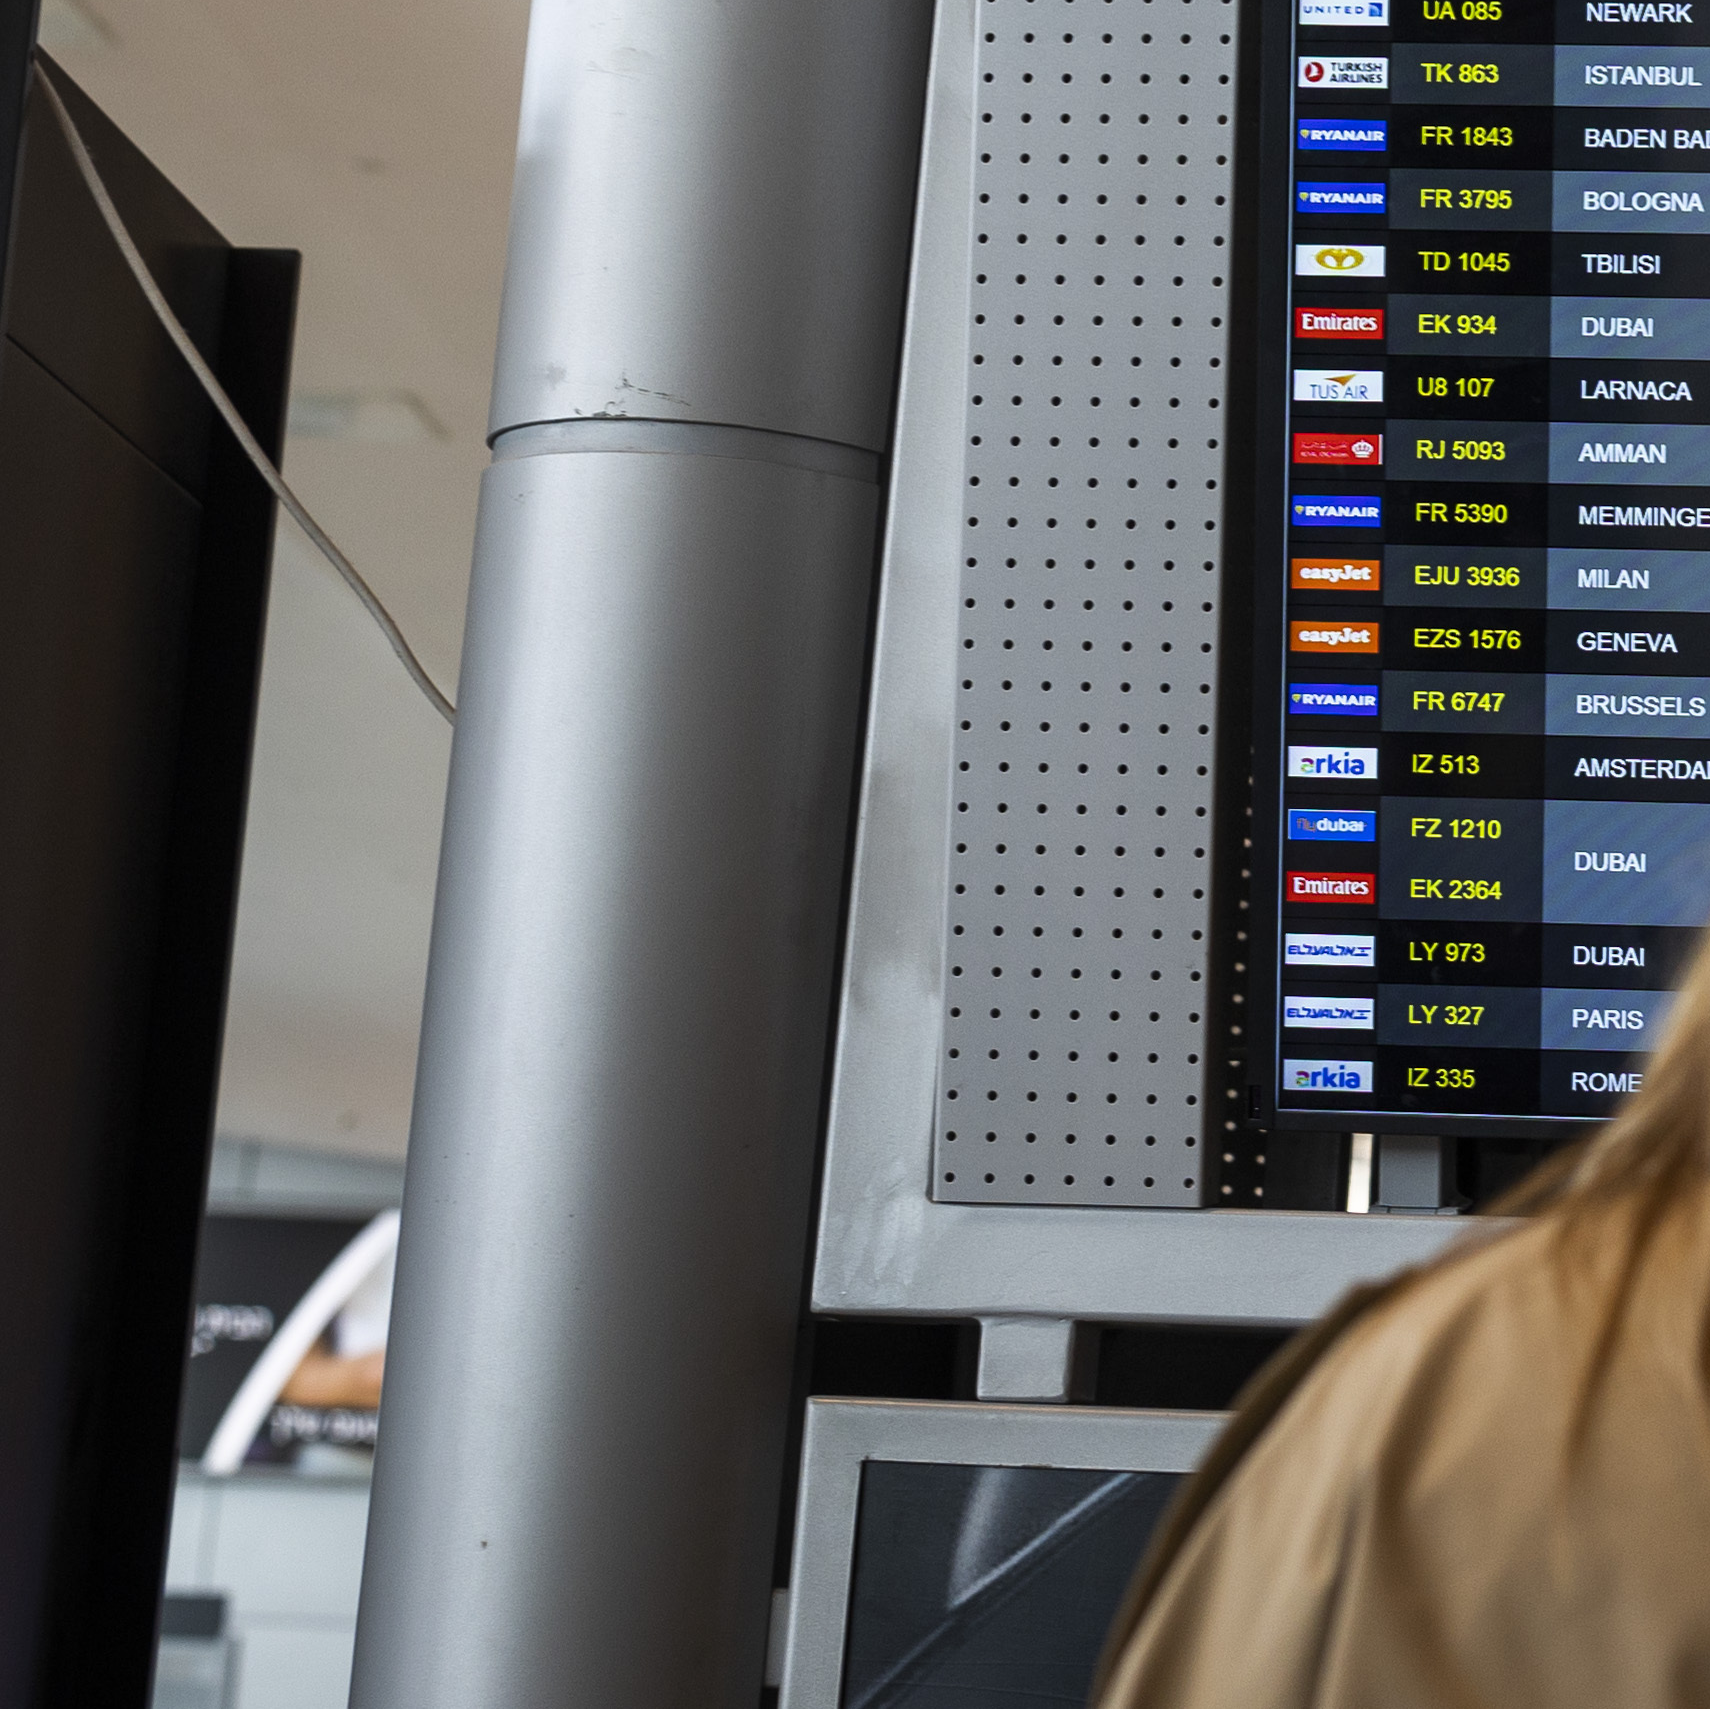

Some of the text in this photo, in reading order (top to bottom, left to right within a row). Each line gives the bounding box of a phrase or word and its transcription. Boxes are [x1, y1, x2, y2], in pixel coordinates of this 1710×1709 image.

[1302, 5, 1365, 14] UNITED
[1422, 0, 1503, 22] UA 085
[1585, 1, 1694, 24] NEWARK
[1420, 125, 1514, 147] FR 1843
[1583, 127, 1668, 150] BADEN
[1310, 383, 1368, 400] TUS AIR
[1417, 376, 1496, 398] U8 107
[1580, 379, 1694, 402] LARNACA
[1415, 502, 1509, 524] FR 5390
[1299, 565, 1371, 583] easyJet
[1413, 627, 1522, 650] EZS 1576
[1576, 631, 1679, 654] GENEVA
[1300, 751, 1365, 775] arkia
[1411, 753, 1481, 775] IZ 513
[1293, 876, 1369, 895] Emirates
[1408, 1004, 1486, 1026] LY 327
[1571, 1008, 1645, 1030] PARIS
